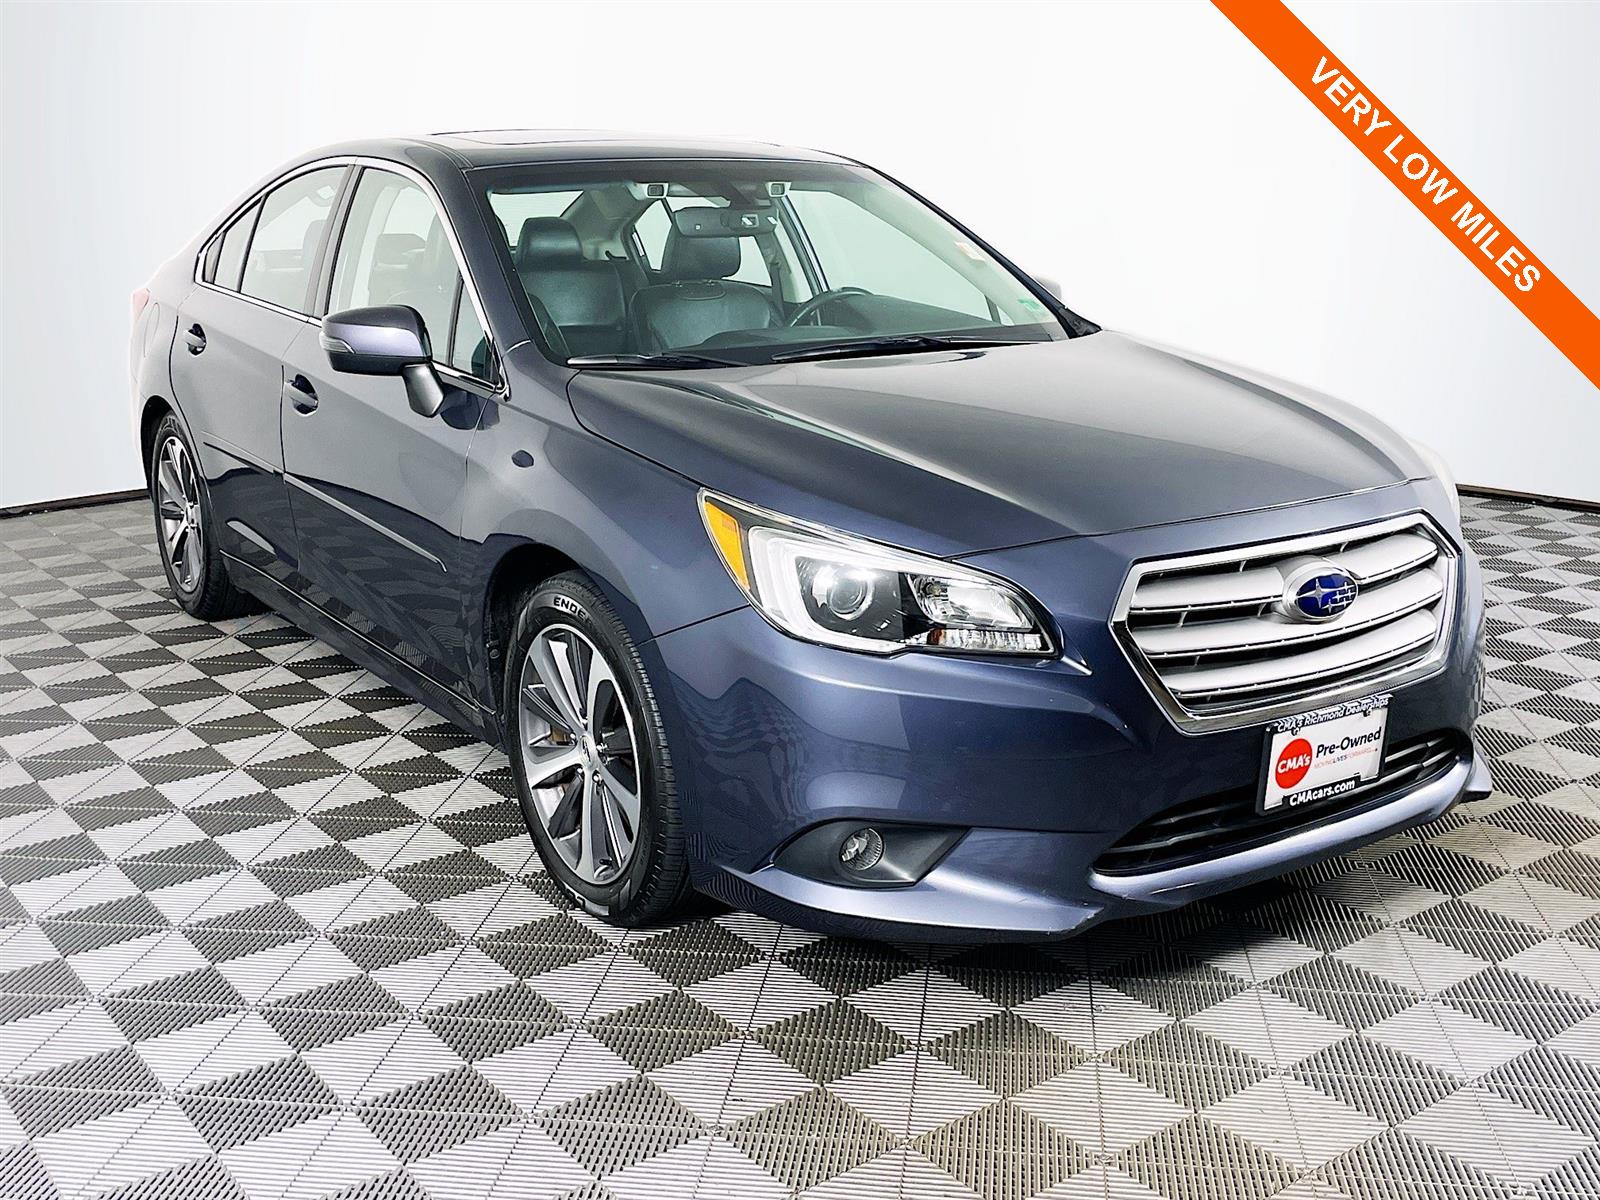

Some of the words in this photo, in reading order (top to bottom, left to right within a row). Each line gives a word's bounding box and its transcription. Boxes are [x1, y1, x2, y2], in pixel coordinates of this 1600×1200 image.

[553, 596, 593, 627] ENDE
[1303, 708, 1345, 727] Richmond
[1345, 697, 1390, 715] Dealerships
[1315, 727, 1382, 758] Pre-Owned
[1276, 753, 1312, 774] CMA's
[1289, 779, 1356, 806] CMAcars.com
